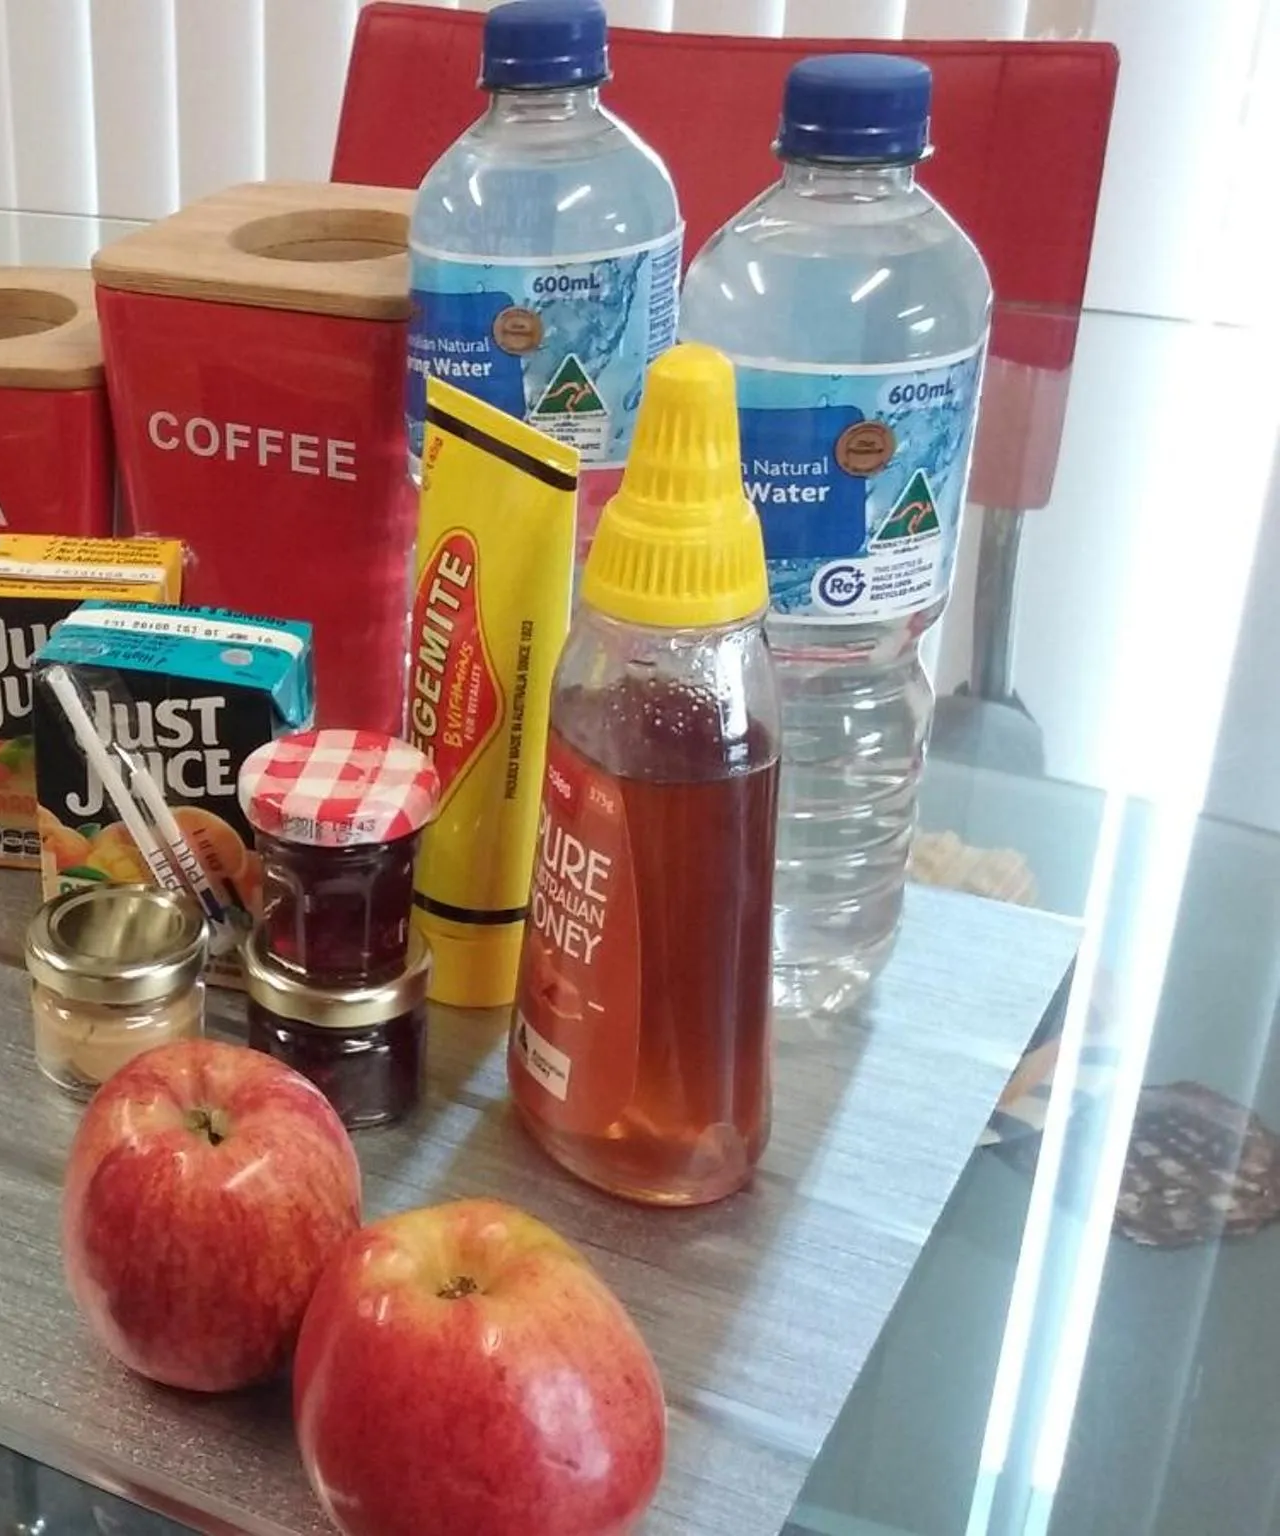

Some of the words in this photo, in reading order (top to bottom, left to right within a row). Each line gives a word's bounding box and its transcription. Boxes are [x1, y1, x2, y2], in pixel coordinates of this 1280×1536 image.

[532, 271, 602, 294] 600mL
[437, 335, 490, 354] Natural
[432, 357, 493, 378] Water
[888, 379, 954, 406] 600mL
[147, 410, 358, 482] COFFEE
[753, 456, 830, 477] Natural
[745, 482, 831, 504] Water
[410, 550, 472, 763] EGEMITE
[447, 640, 474, 729] VITAMINS
[467, 662, 483, 715] VITALITY
[442, 730, 464, 749] B
[171, 839, 206, 884] PULL
[533, 890, 603, 965] ONEY
